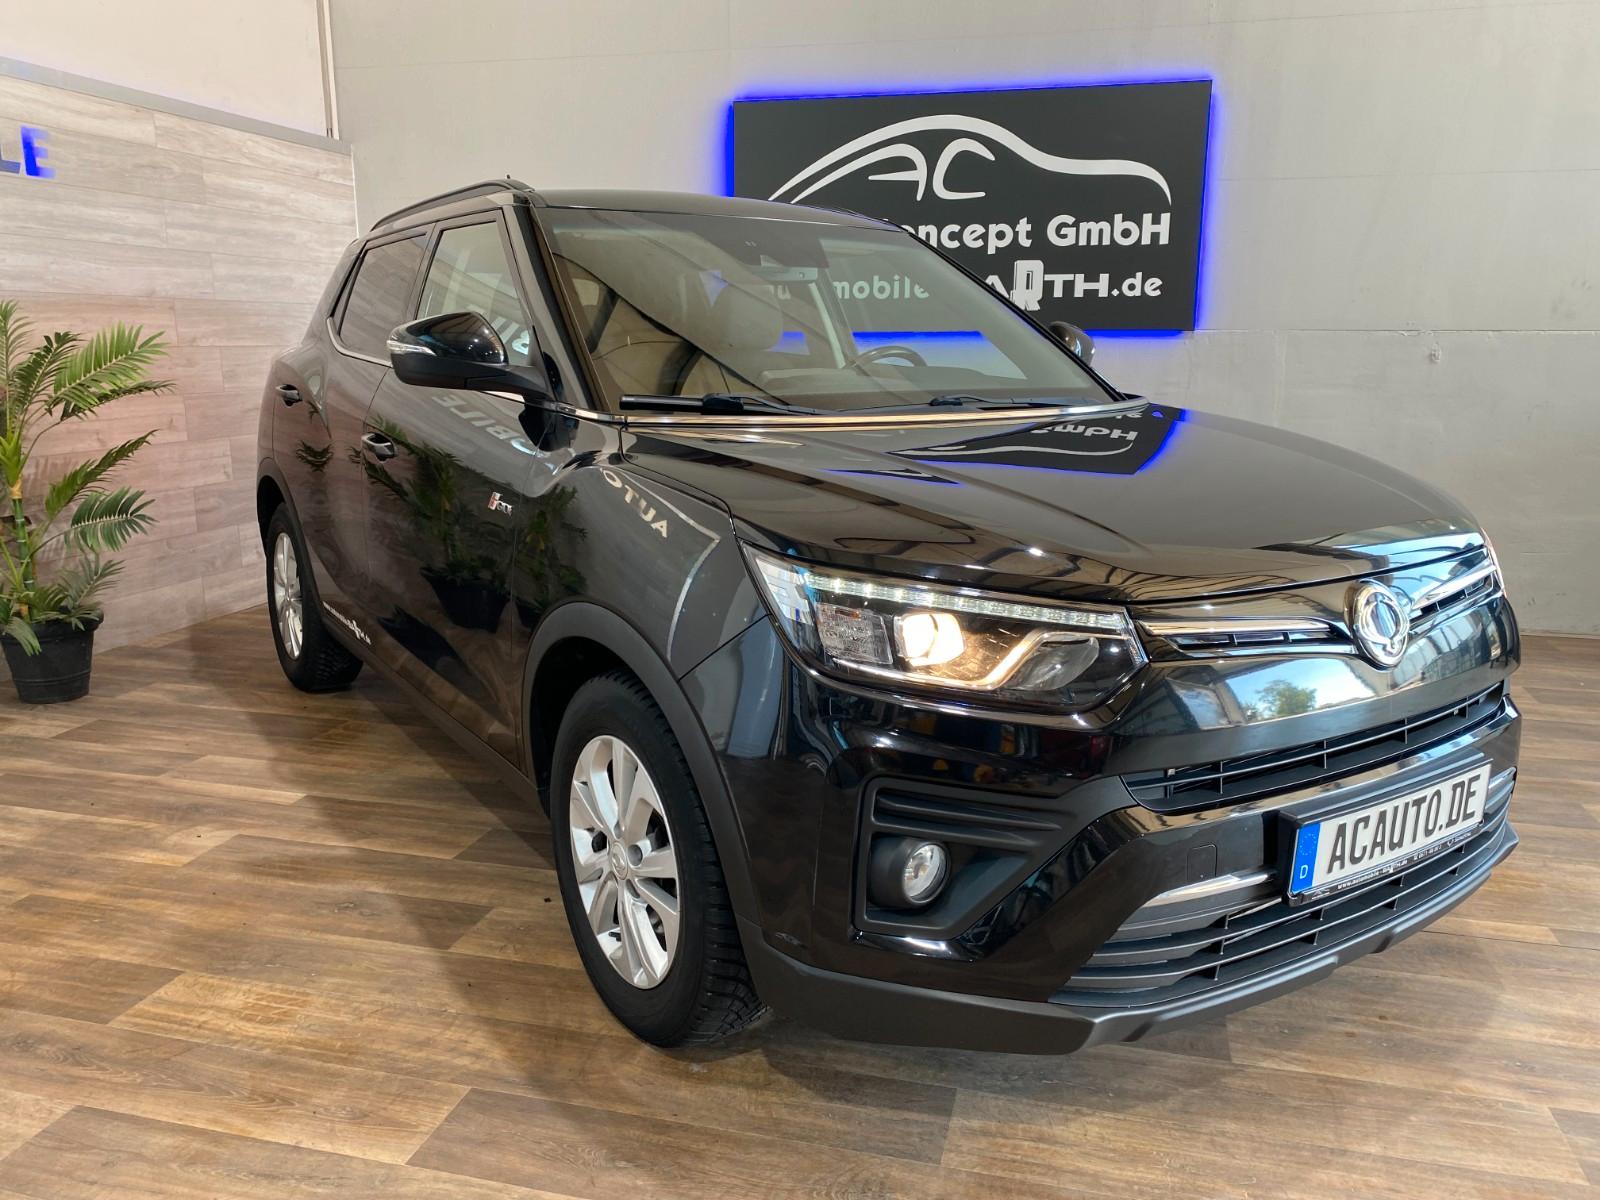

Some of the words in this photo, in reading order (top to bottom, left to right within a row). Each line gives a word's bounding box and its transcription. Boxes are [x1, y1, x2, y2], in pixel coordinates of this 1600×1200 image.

[1046, 212, 1171, 247] GmbH
[1327, 774, 1481, 874] ACAUTO.DE
[1299, 864, 1308, 879] D
